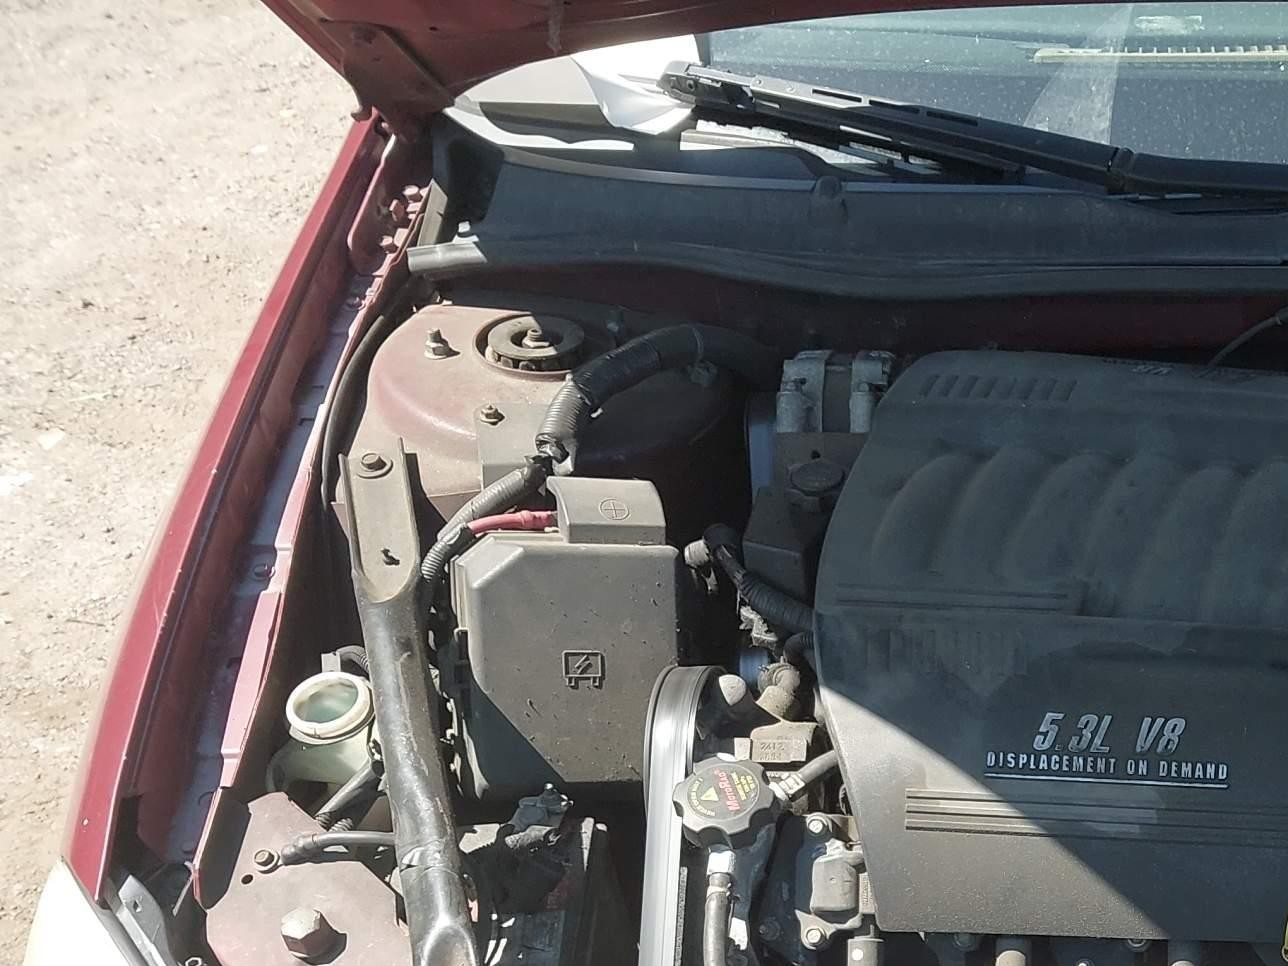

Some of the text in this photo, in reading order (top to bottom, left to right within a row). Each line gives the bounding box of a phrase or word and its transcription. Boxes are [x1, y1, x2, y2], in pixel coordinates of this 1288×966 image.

[1033, 712, 1186, 754] 5.3L V8
[986, 752, 1228, 780] DISPLACEMENT ON DEMAND
